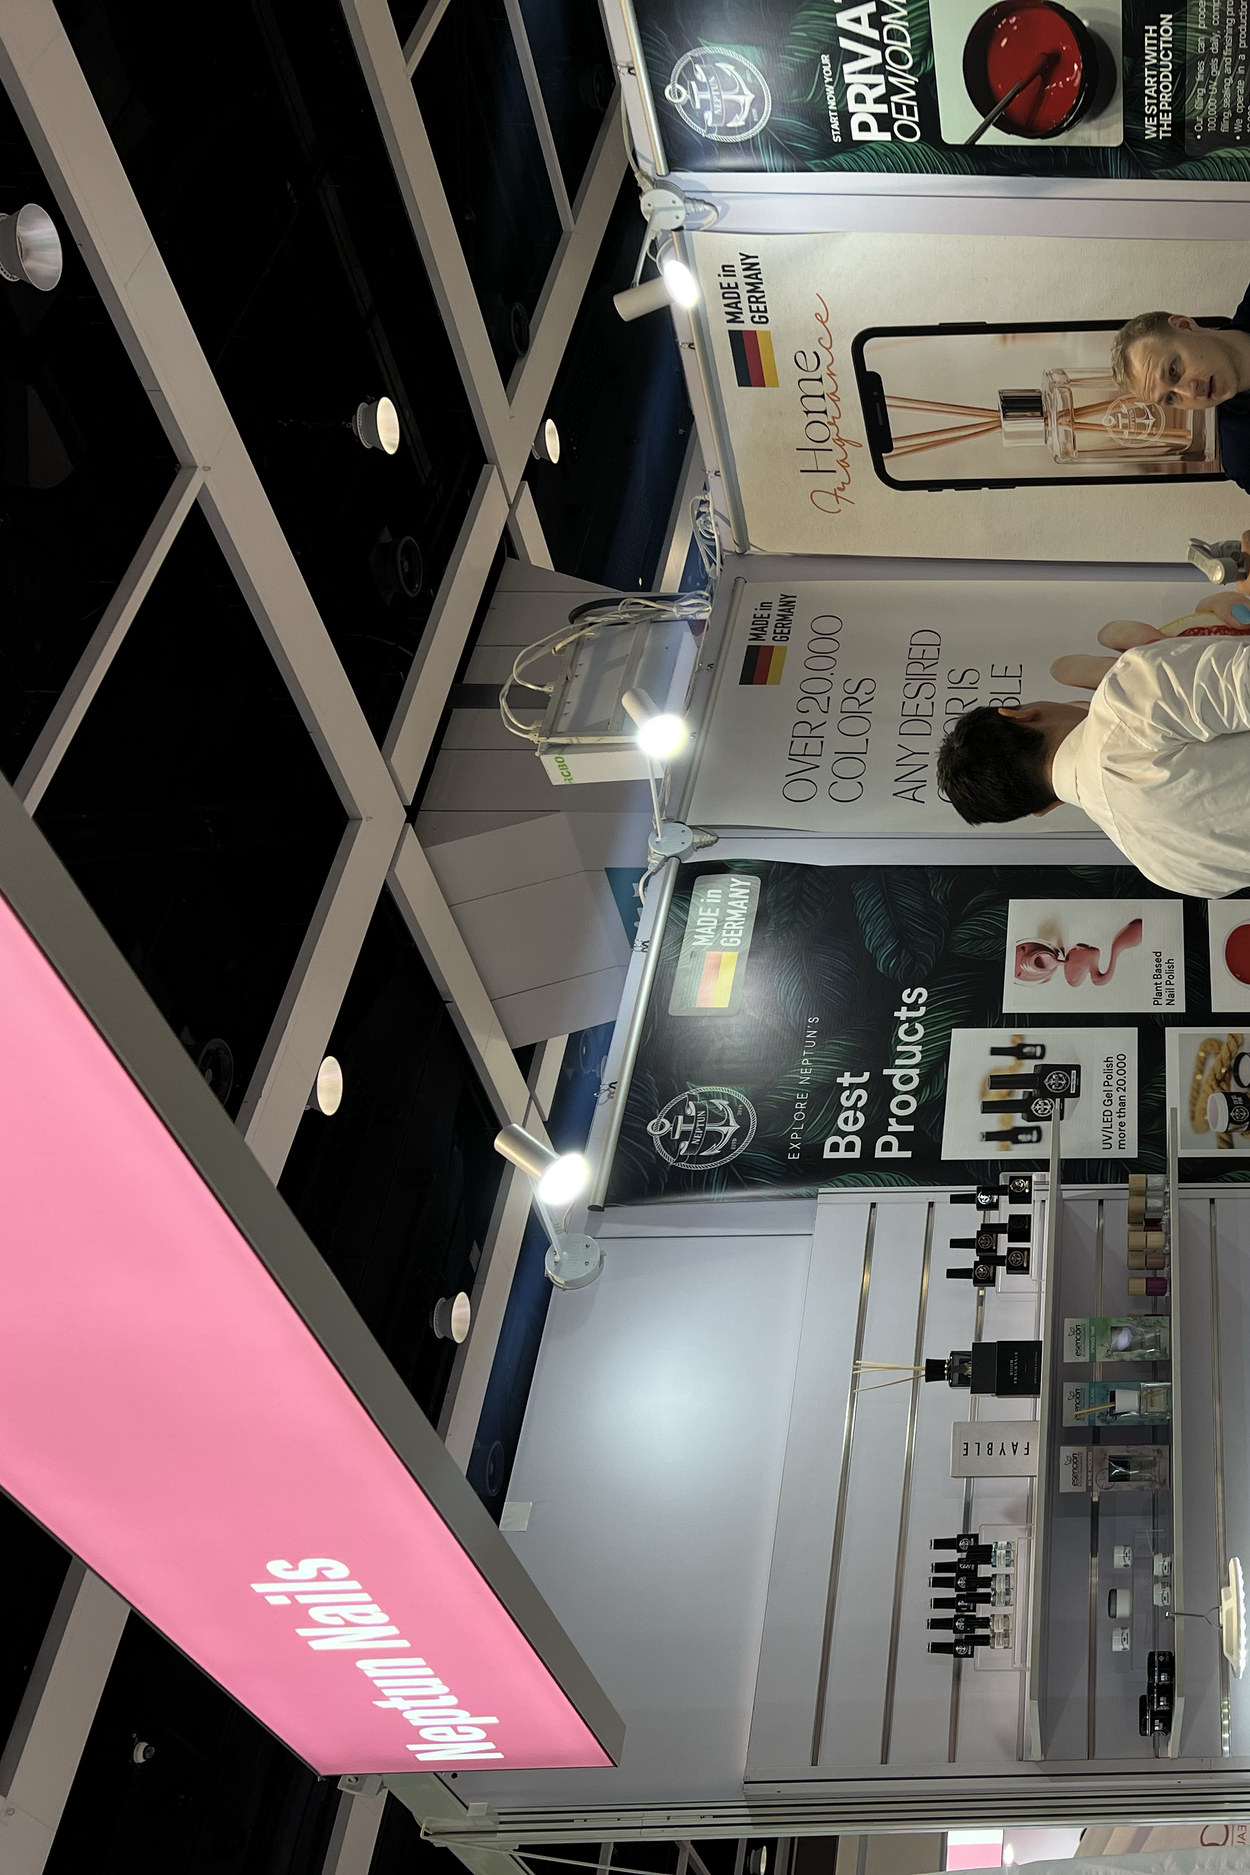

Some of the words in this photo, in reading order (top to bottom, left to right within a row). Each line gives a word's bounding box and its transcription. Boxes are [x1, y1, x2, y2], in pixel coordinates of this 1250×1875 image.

[1144, 25, 1158, 66] WITH
[1198, 36, 1206, 54] can
[1222, 18, 1236, 56] finishing
[820, 54, 834, 84] YOUR
[834, 0, 892, 141] PRIVA
[1160, 14, 1173, 110] PRODUCTION
[1210, 58, 1220, 76] gels
[1223, 57, 1232, 74] and
[1236, 66, 1245, 74] in
[708, 76, 722, 115] NEPTUN
[825, 84, 838, 109] NOW
[1144, 68, 1158, 115] START
[1208, 80, 1217, 94] UV
[1236, 79, 1247, 114] operate
[828, 110, 842, 142] START
[1144, 116, 1158, 140] WE
[1160, 112, 1172, 140] THE
[1194, 116, 1204, 132] Our
[1208, 98, 1218, 132] 100,000
[1234, 118, 1243, 133] We
[718, 264, 737, 278] in
[739, 252, 769, 325] GERMANY
[720, 282, 744, 324] MADE
[793, 350, 836, 474] Home
[810, 292, 862, 514] Fragrance
[754, 602, 772, 610] in
[772, 594, 797, 642] GERMANY
[748, 613, 771, 642] MADE
[796, 614, 843, 714] 20.000
[946, 668, 980, 690] IS
[898, 629, 942, 736] DESIRED
[828, 678, 876, 803] COLORS
[782, 720, 827, 803] OVER
[892, 743, 930, 804] ANY
[701, 889, 722, 903] in
[720, 877, 751, 947] GERMANY
[692, 907, 720, 946] MADE
[1152, 951, 1162, 980] Based
[1164, 958, 1174, 986] Polish
[1152, 982, 1162, 1006] Plant
[1165, 988, 1175, 1006] Nail
[798, 1016, 820, 1085] NEPTUN'S
[874, 986, 928, 1159] Products
[1103, 1056, 1114, 1087] Polish
[1116, 1054, 1126, 1093] 20.000
[822, 1071, 870, 1159] Best
[1102, 1090, 1114, 1107] Gel
[1116, 1095, 1126, 1119] than
[691, 1110, 706, 1145] NEPTUN
[788, 1092, 809, 1160] EXPLORE
[1102, 1109, 1114, 1150] UV/LED
[1118, 1121, 1126, 1150] more
[962, 1442, 1030, 1456] FAYBLE
[250, 1558, 411, 1650] Nails
[356, 1658, 504, 1761] Neptun
